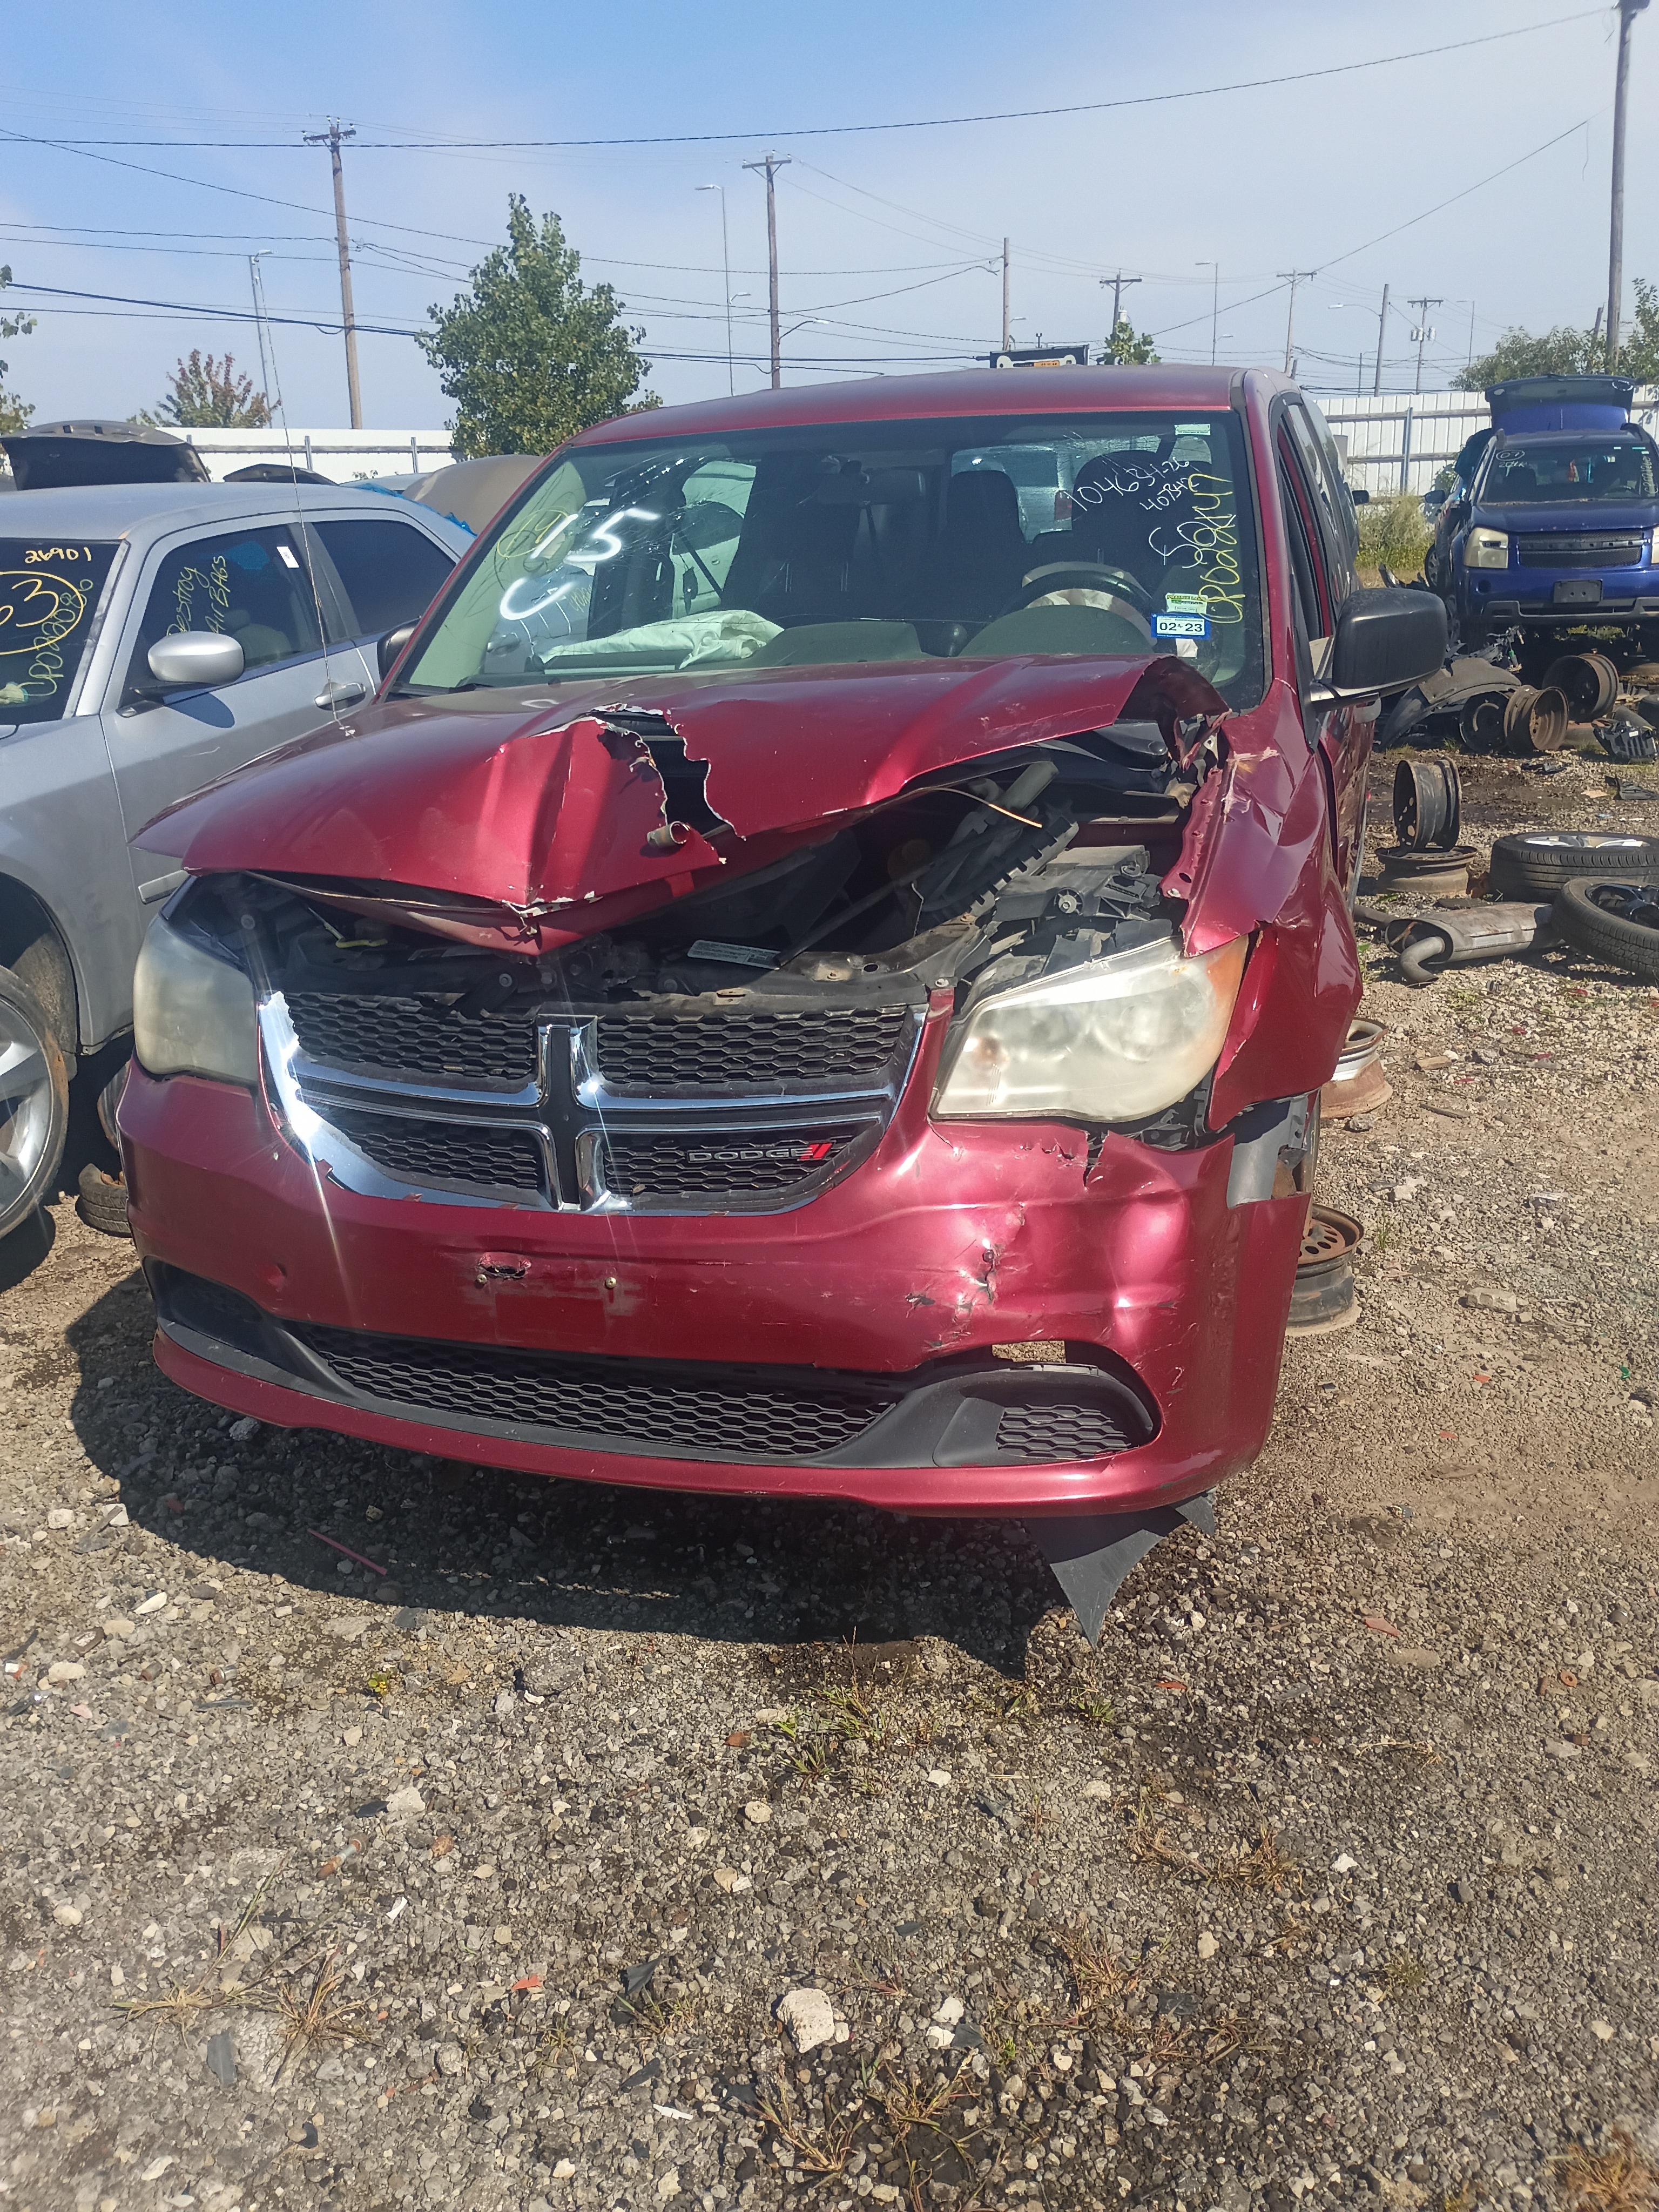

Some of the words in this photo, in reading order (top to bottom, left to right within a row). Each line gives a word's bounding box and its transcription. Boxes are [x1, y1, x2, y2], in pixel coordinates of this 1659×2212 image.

[25, 547, 92, 564] 26901
[1159, 622, 1177, 631] 02
[1185, 623, 1203, 632] 23
[689, 1147, 813, 1162] DODGE
